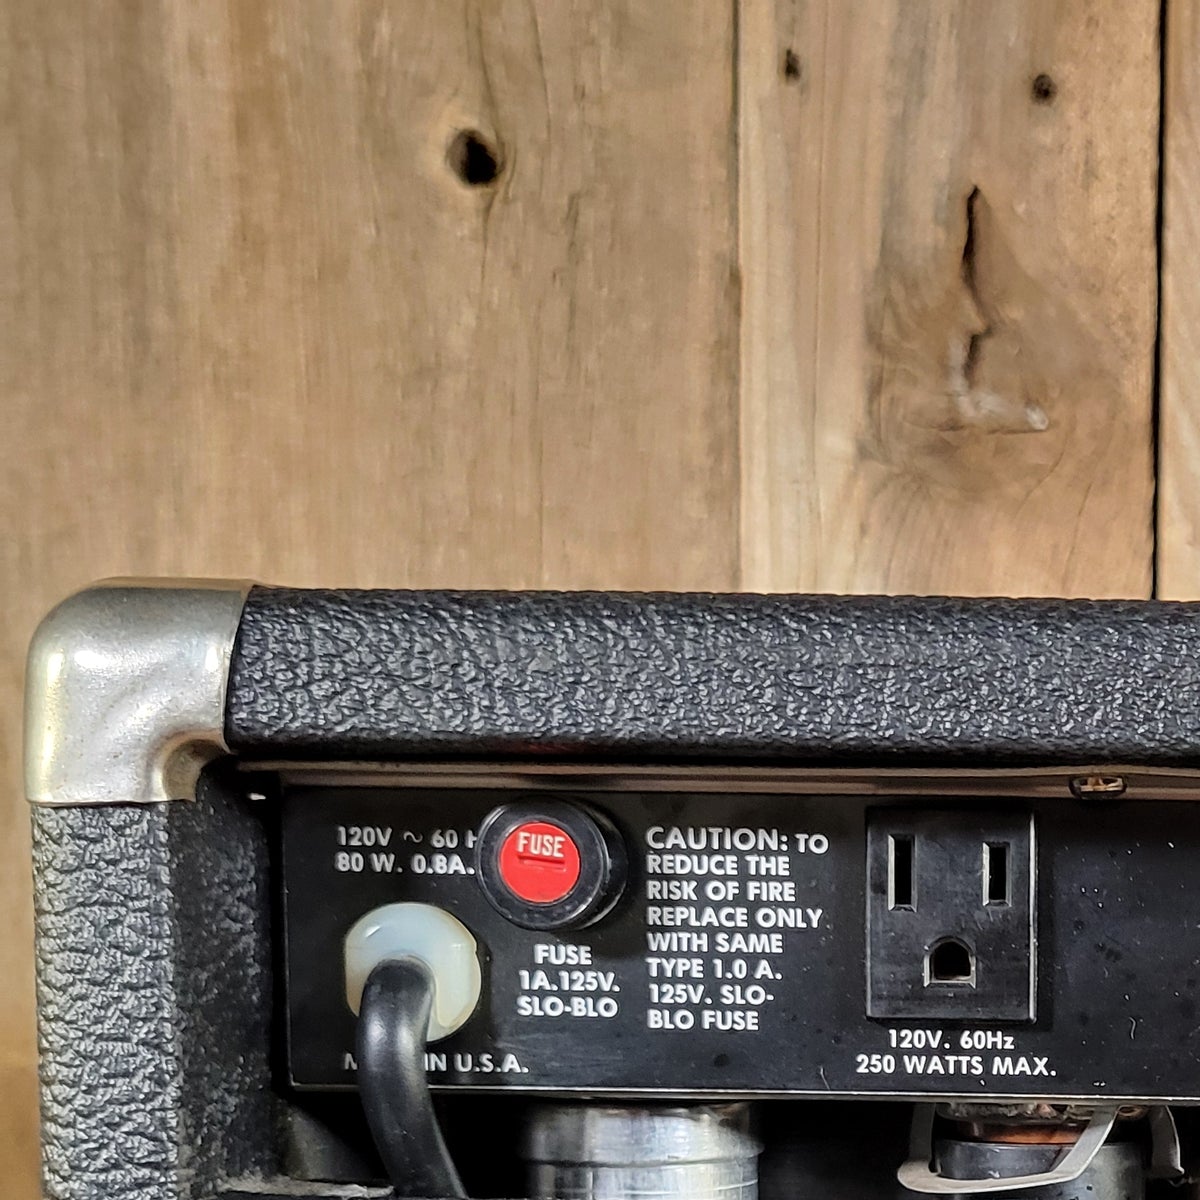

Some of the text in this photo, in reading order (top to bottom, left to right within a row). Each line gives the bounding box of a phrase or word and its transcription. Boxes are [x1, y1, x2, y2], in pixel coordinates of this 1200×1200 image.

[337, 826, 393, 847] 120V
[430, 829, 459, 849] 60
[517, 831, 566, 858] FUSE
[645, 825, 829, 855] CAUTION: TO
[335, 852, 476, 875] 80 W. 0.8A.
[646, 855, 791, 877] REDUCE THE
[646, 880, 796, 902] RISK OF FIRE
[646, 905, 823, 929] REPLACE ONLY
[534, 944, 592, 965] FUSE
[646, 932, 784, 955] WITH SAME
[647, 957, 783, 981] TYPE 1.0 A.
[648, 984, 775, 1006] 125V. SLO-
[516, 996, 619, 1018] SLO-BLO
[646, 1008, 760, 1031] BLO FUSE
[888, 1029, 1015, 1051] 120V. 60Hz
[454, 1053, 530, 1073] U.S.A.
[856, 1053, 1057, 1077] 250 WATTS MAX.
